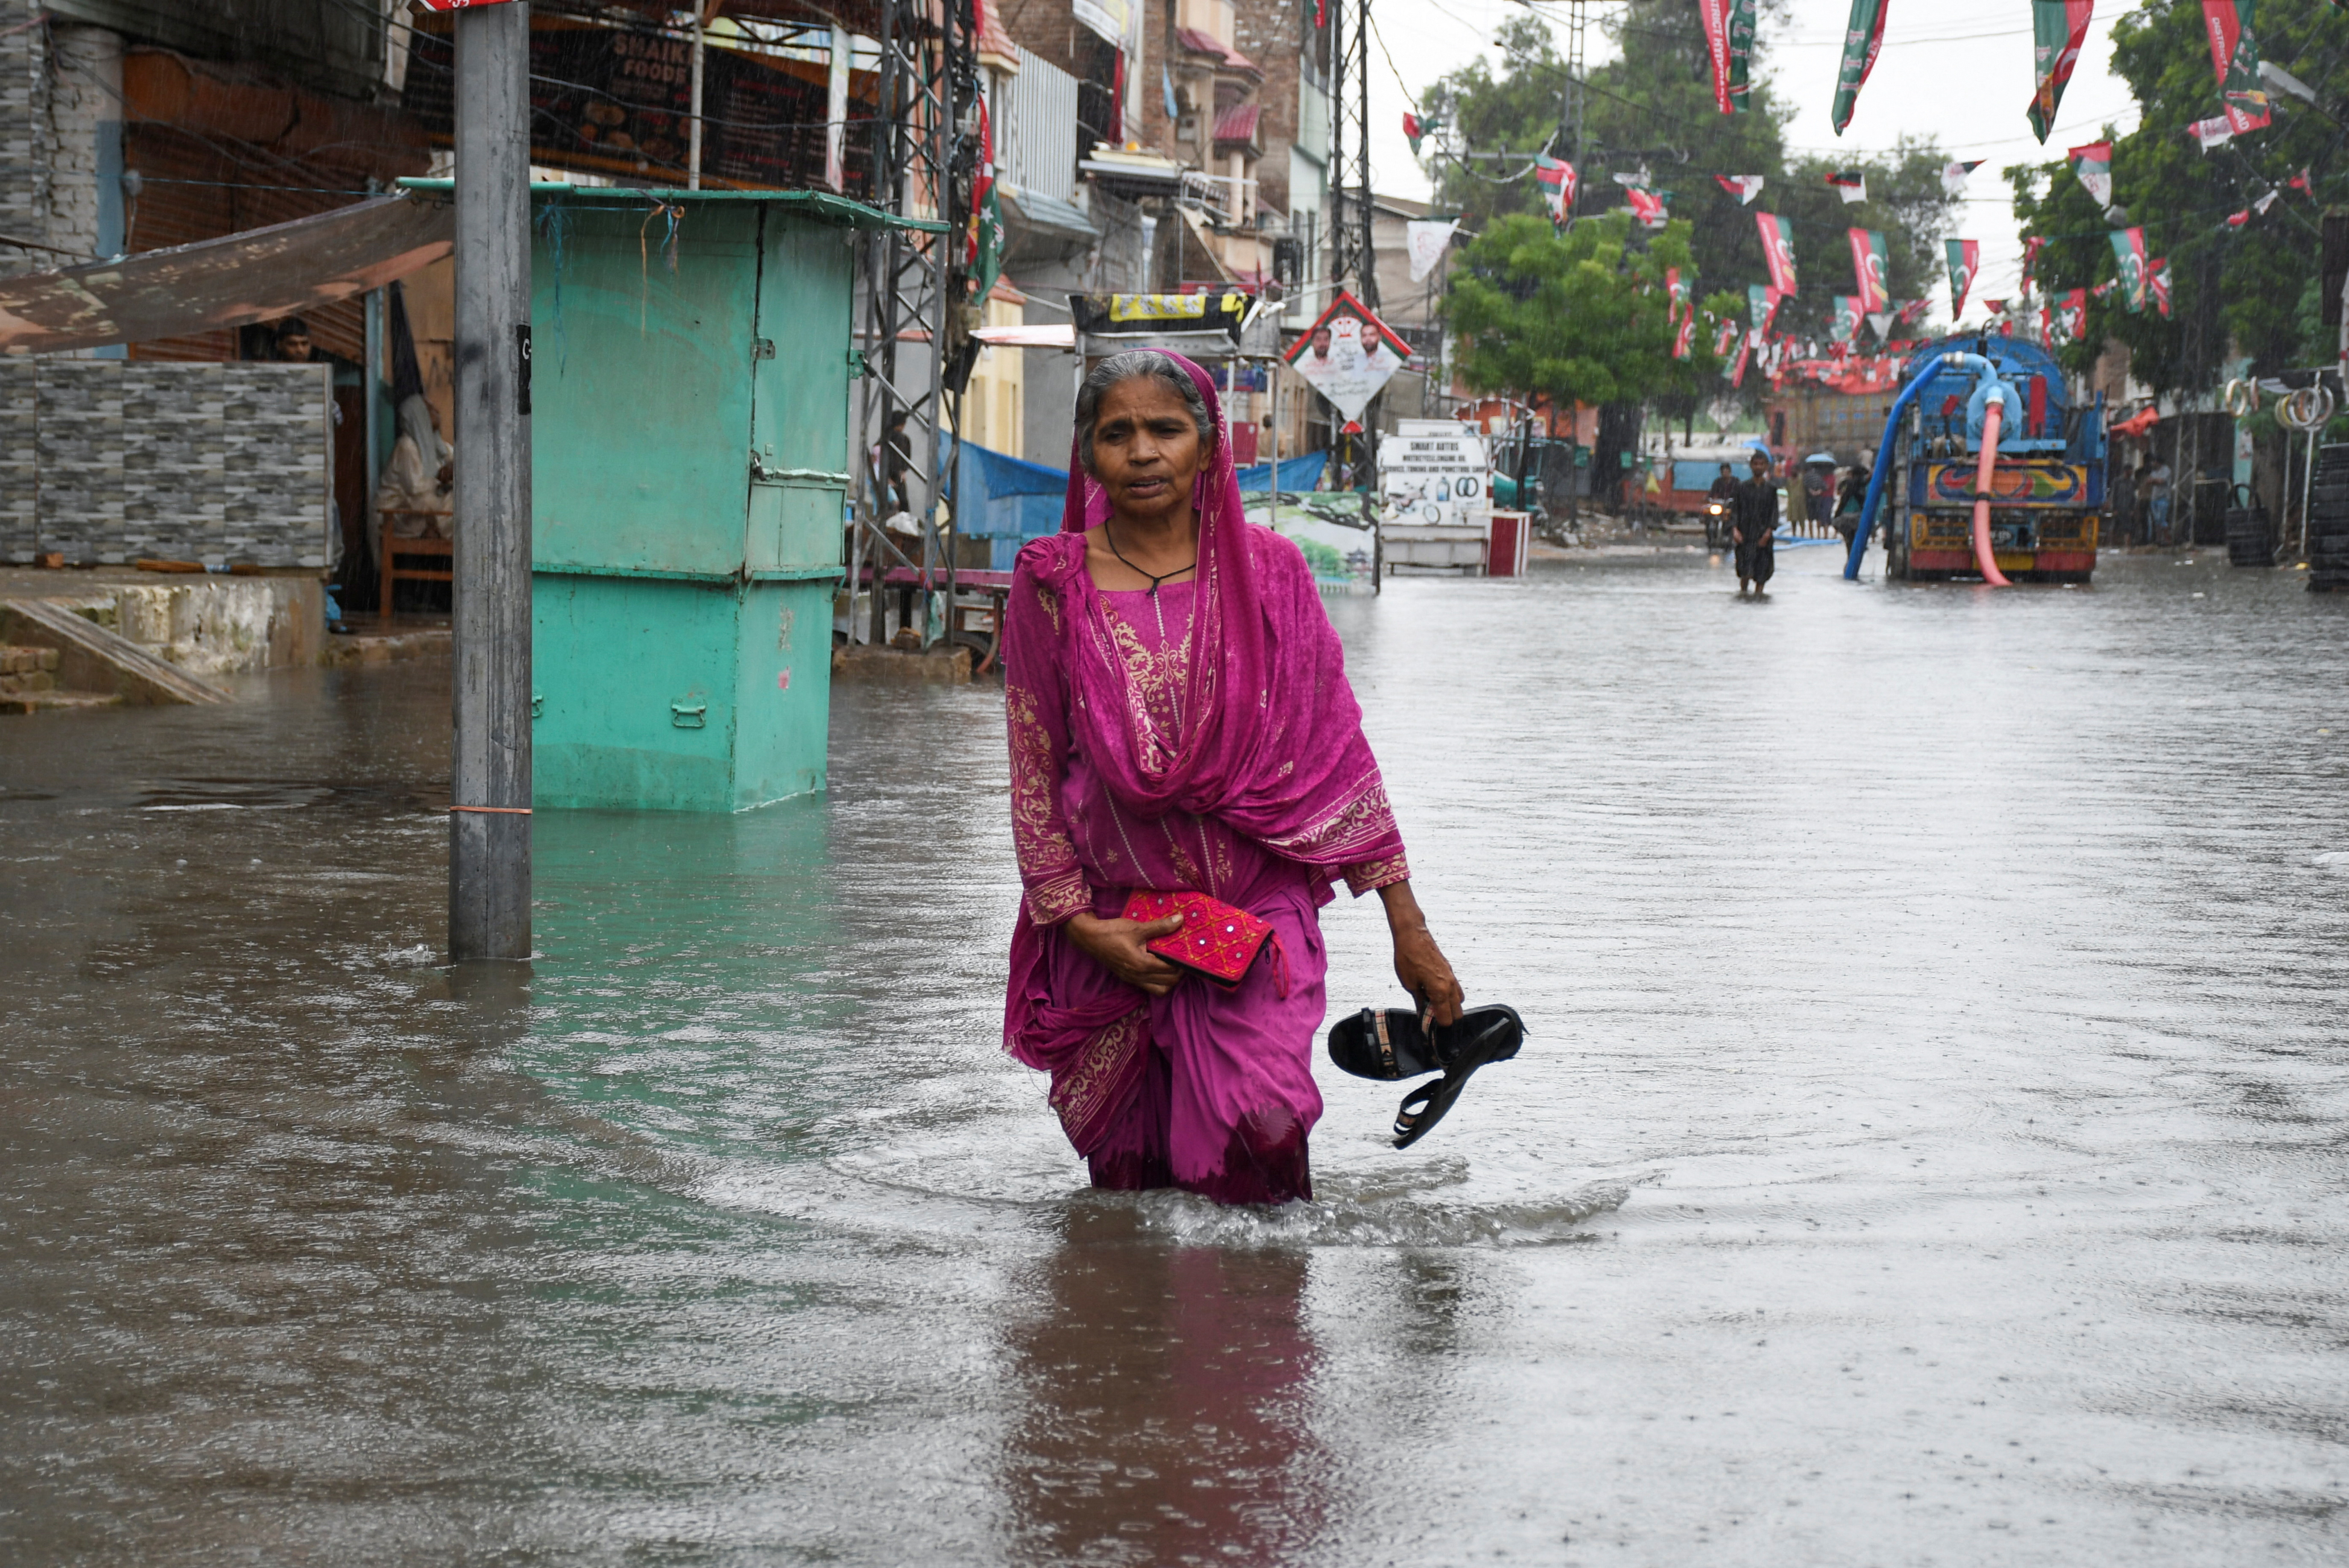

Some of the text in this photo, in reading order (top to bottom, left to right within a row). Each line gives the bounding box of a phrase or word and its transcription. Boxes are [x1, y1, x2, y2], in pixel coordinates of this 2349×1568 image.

[2212, 17, 2228, 65] DISTRICT
[624, 59, 687, 85] FOODS
[1411, 442, 1458, 450] SMART AUTOS
